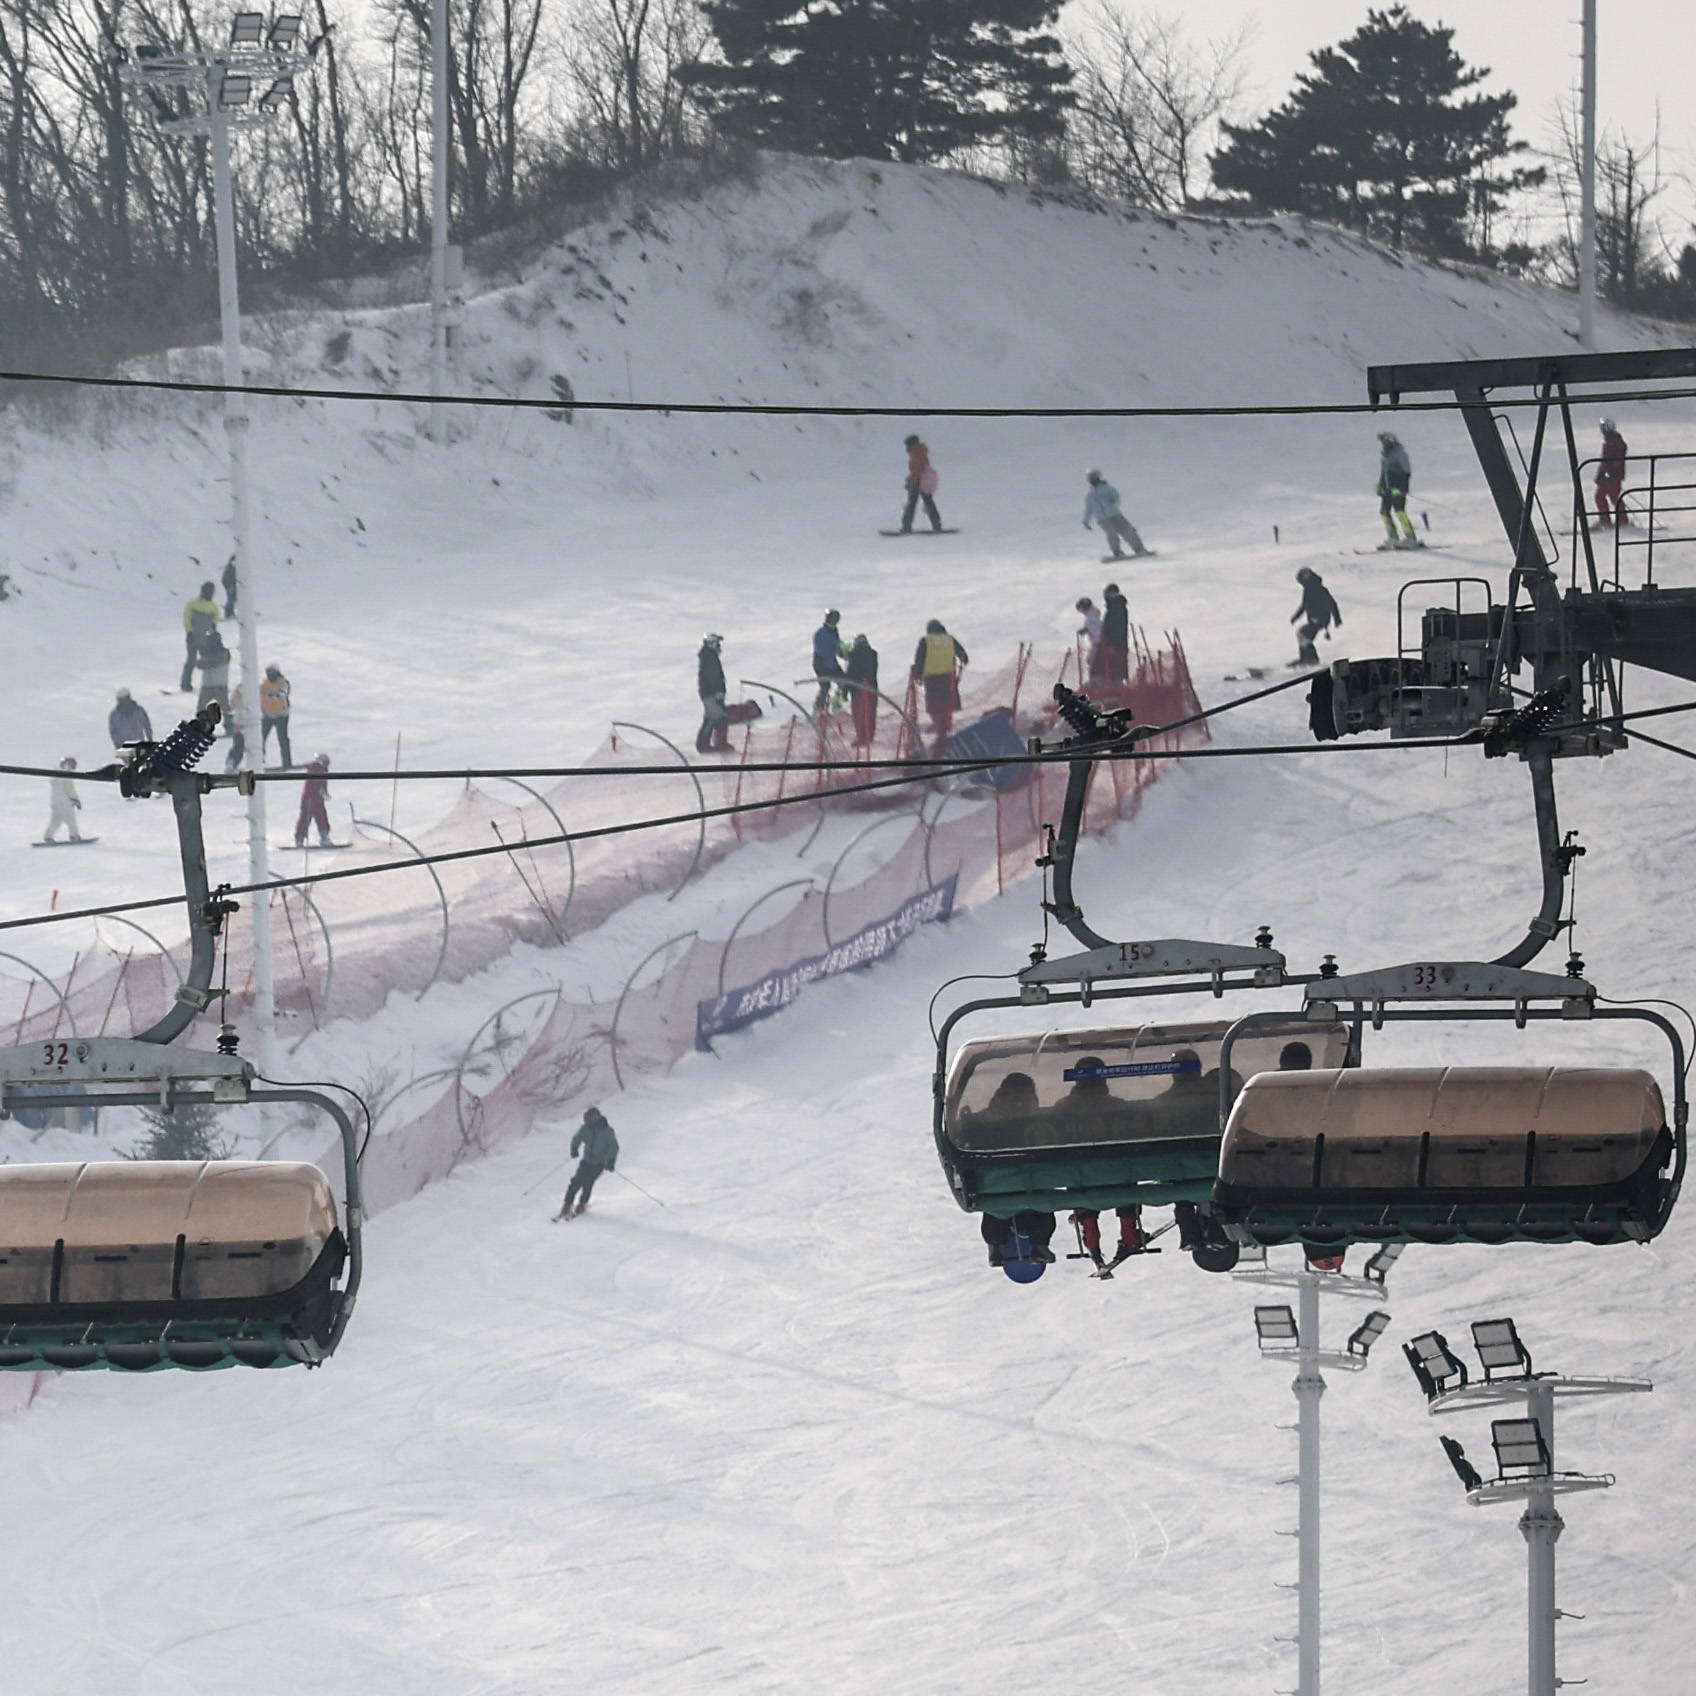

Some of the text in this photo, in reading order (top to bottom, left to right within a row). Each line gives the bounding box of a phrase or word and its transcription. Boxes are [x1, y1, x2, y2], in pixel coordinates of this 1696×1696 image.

[1119, 944, 1140, 961] 15
[1415, 965, 1437, 985] 33
[42, 1042, 69, 1066] 32
